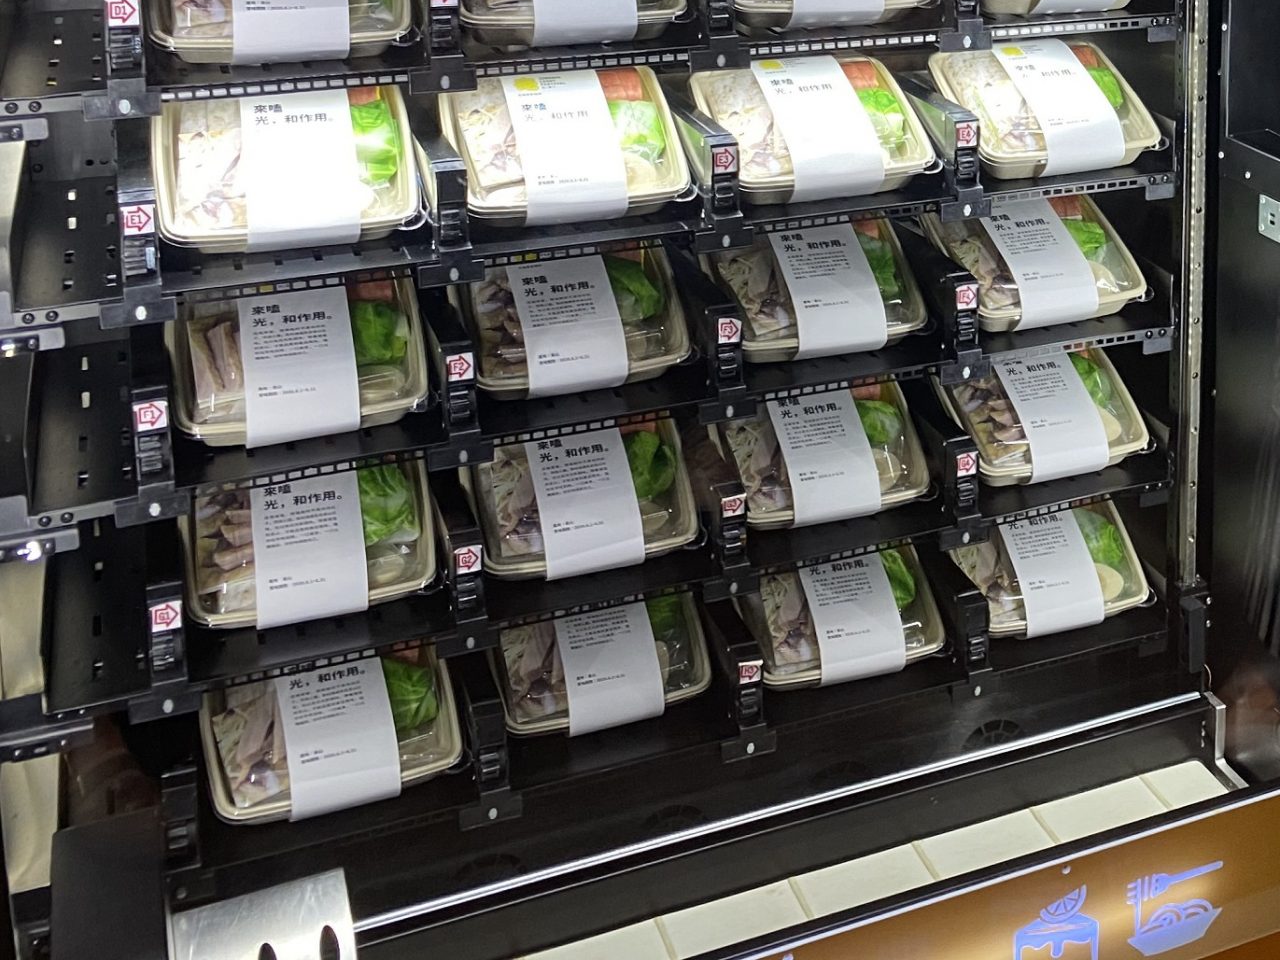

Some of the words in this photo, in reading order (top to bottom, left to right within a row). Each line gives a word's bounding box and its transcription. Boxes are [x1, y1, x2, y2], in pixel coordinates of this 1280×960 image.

[113, 4, 127, 17] D1
[253, 103, 283, 114] 來嗑
[130, 214, 143, 225] E1
[251, 304, 281, 316] 來嗑
[452, 361, 464, 372] F2
[461, 554, 473, 566] G2
